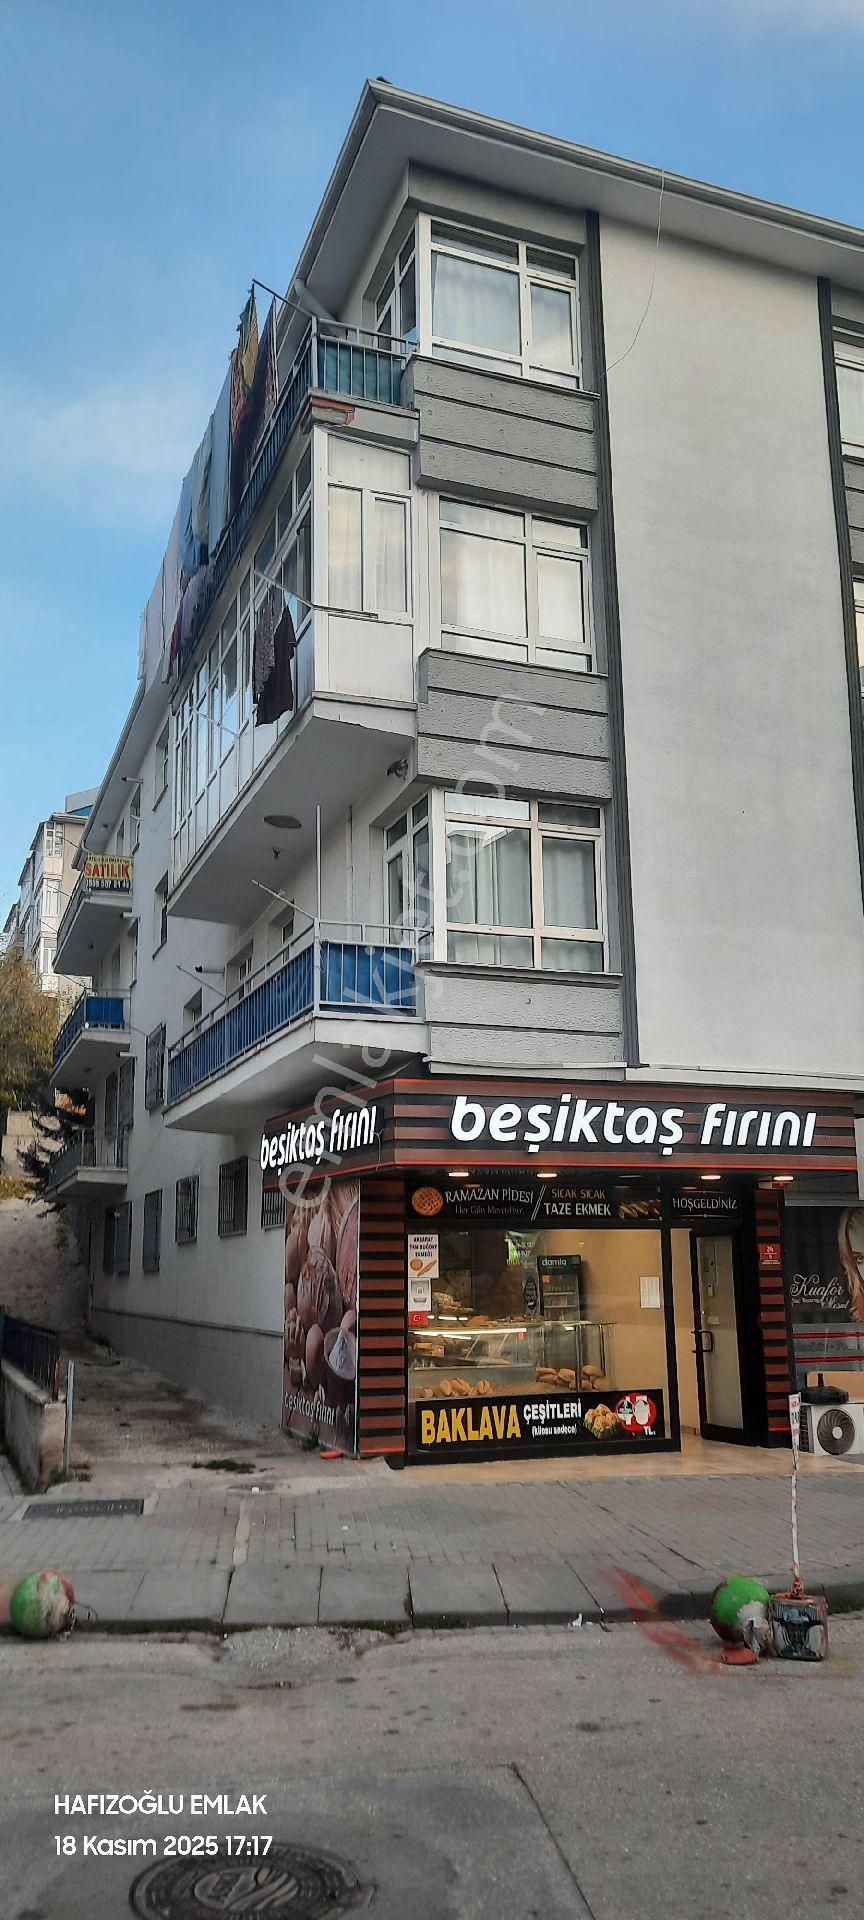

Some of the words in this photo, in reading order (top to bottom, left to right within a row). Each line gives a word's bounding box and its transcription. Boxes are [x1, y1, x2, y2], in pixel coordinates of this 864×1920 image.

[85, 862, 130, 879] SATILIK
[450, 1093, 685, 1156] beşiktaş
[700, 1103, 817, 1148] fırını
[260, 1120, 325, 1176] beşiktaş
[329, 1105, 377, 1153] fırını
[445, 1186, 499, 1204] RAMAZAN
[551, 1188, 577, 1200] SICAK
[580, 1189, 606, 1200] SICAK
[455, 1204, 469, 1215] Her
[543, 1202, 572, 1216] TAZE
[575, 1202, 611, 1217] EKMEK
[672, 1196, 738, 1212] HOŞGELDİNİZ
[541, 1258, 567, 1267] damla
[790, 1274, 844, 1304] Kuaför
[421, 1404, 522, 1446] BAKLAVA
[523, 1398, 582, 1425] ÇEŞİTLERİ
